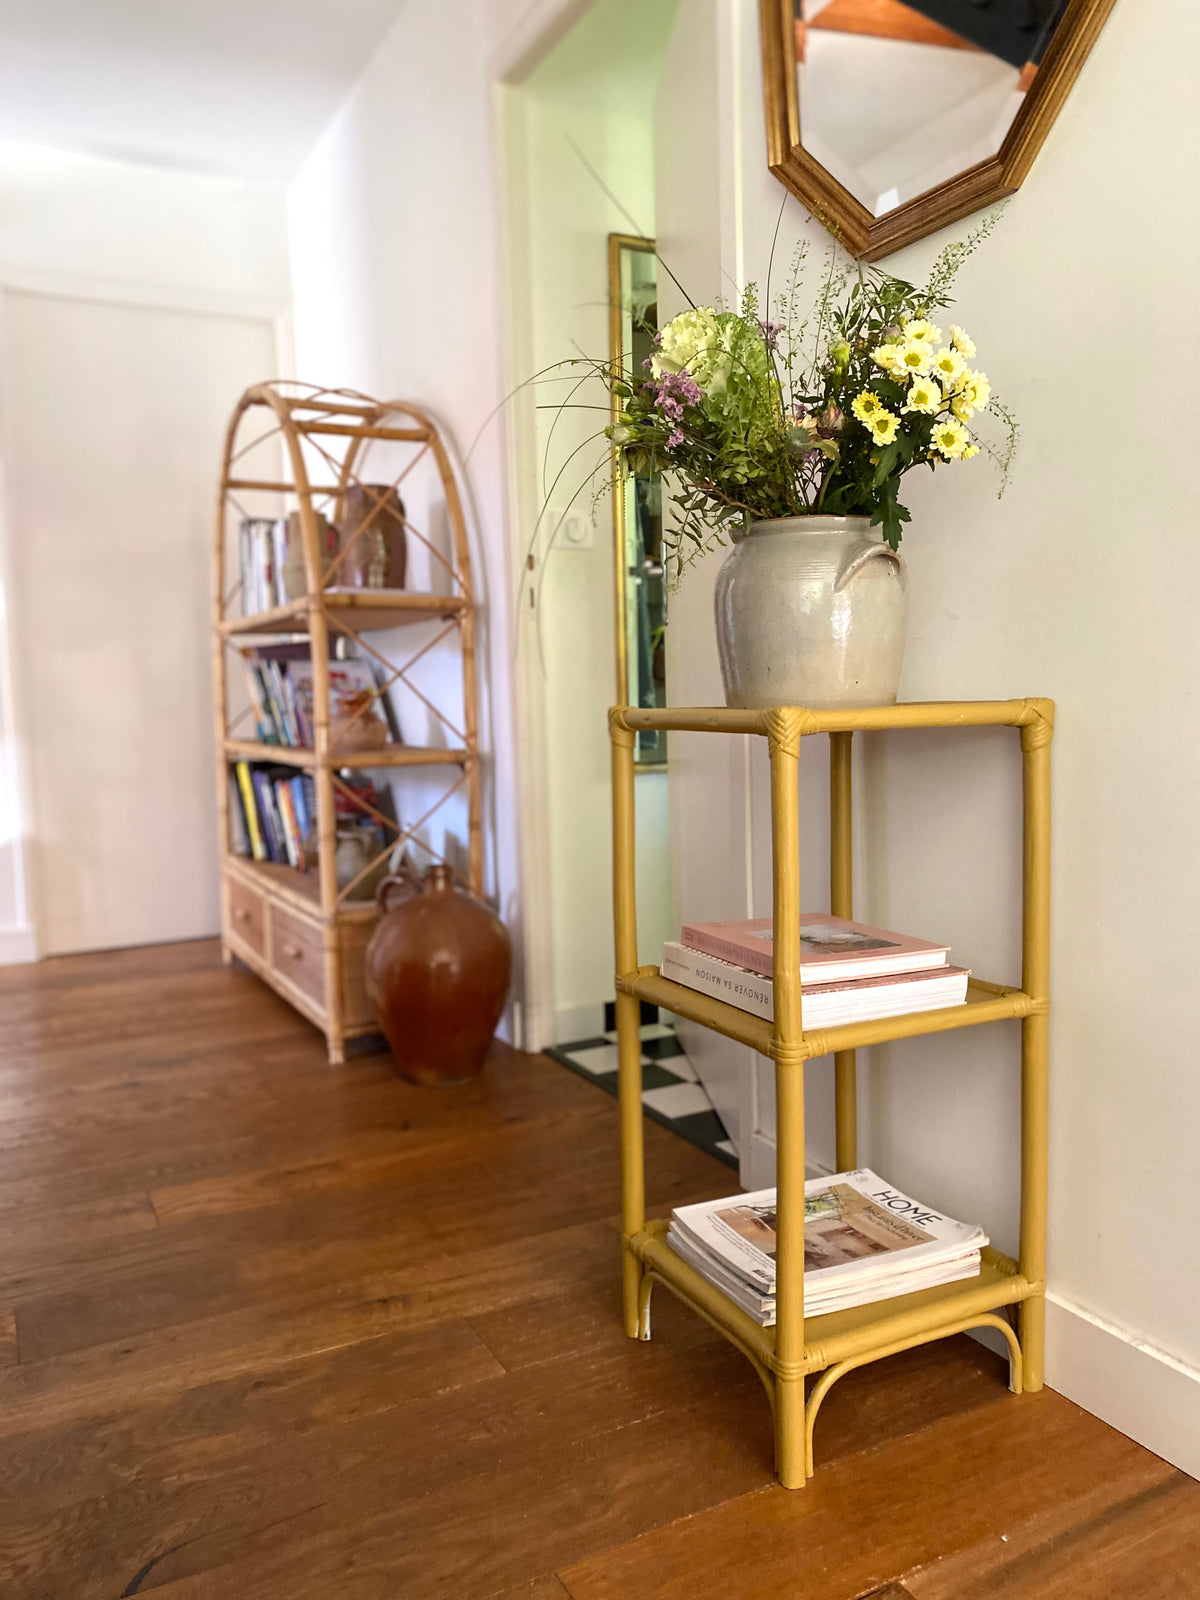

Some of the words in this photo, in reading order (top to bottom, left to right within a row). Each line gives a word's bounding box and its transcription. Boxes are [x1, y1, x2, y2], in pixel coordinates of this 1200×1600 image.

[695, 968, 721, 985] MAISON
[723, 980, 732, 990] SA
[734, 984, 769, 1004] RÉNOVER
[871, 1190, 943, 1226] HOME
